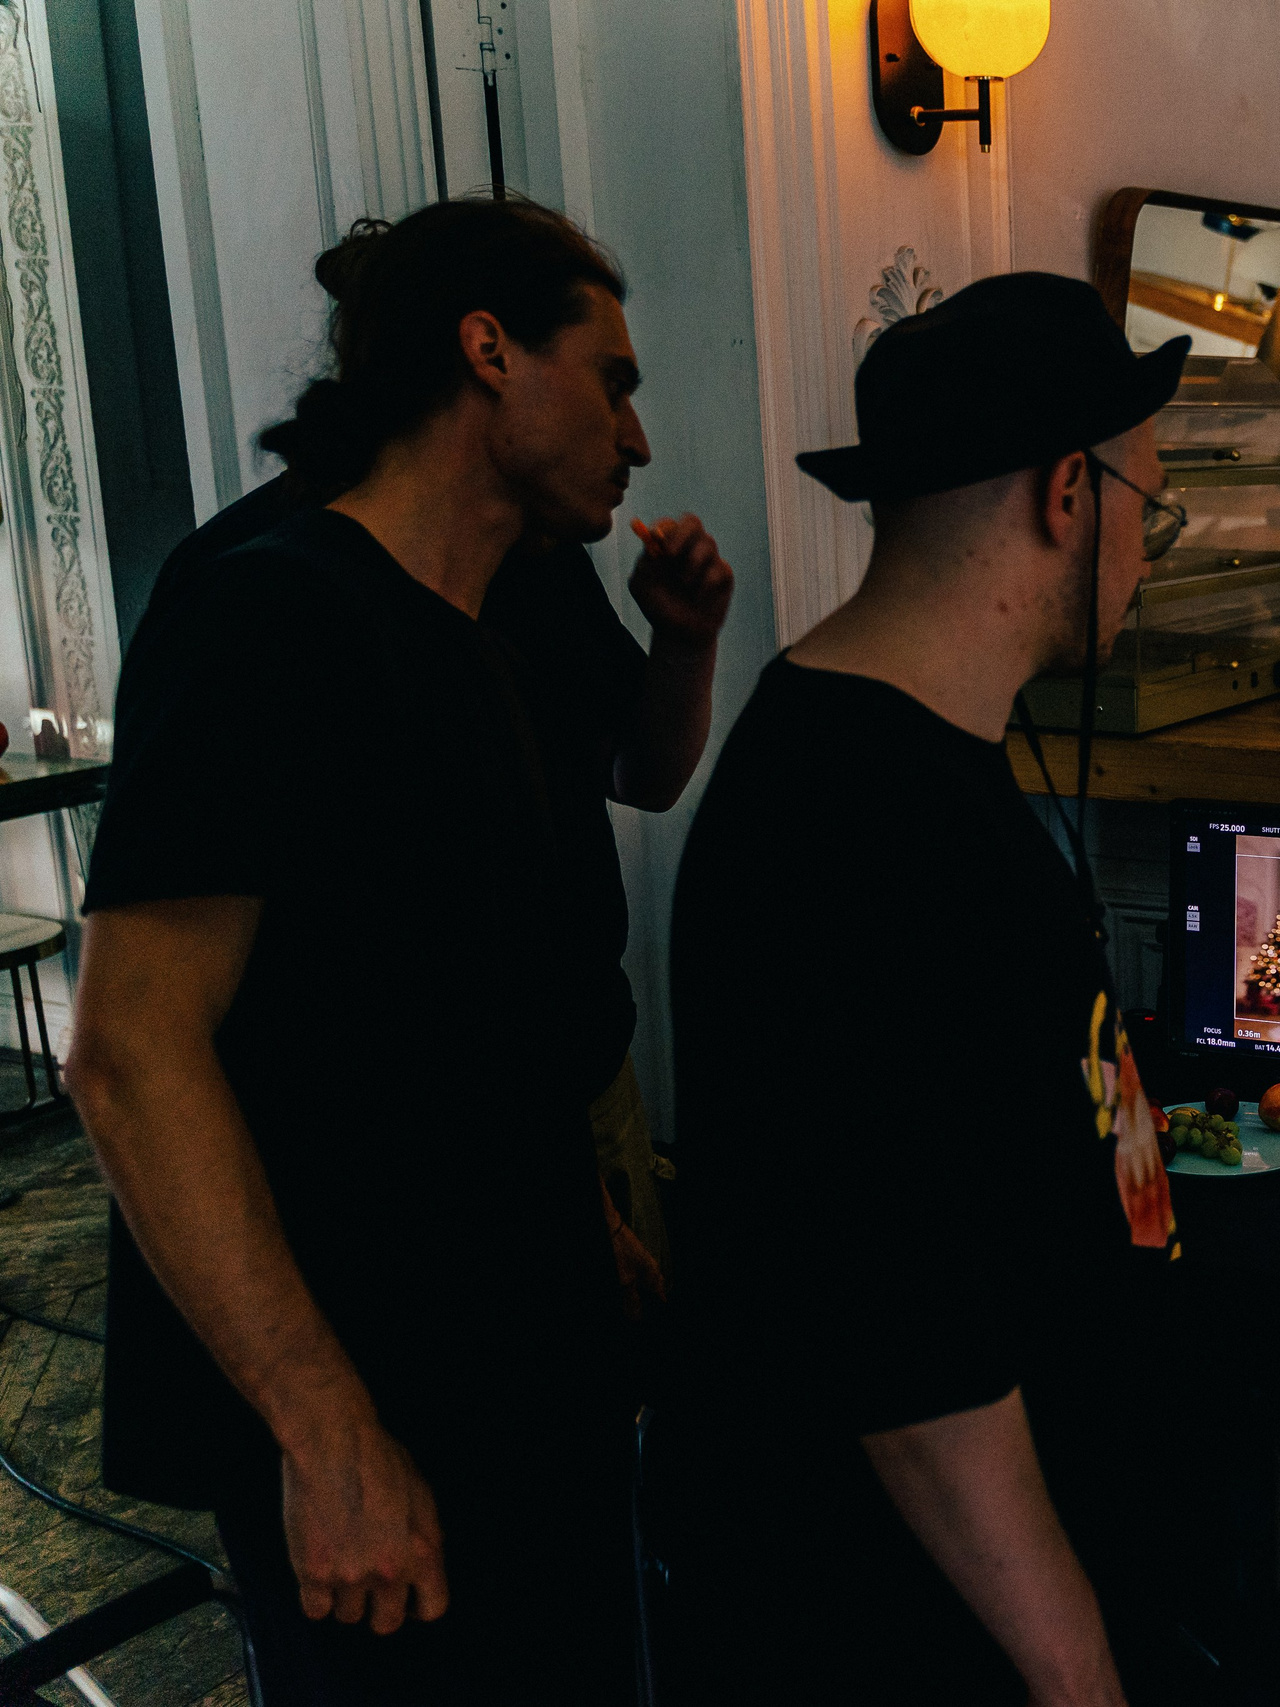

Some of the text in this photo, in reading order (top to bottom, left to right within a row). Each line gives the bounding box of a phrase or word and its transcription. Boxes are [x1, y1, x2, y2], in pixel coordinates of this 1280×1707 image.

[1220, 824, 1245, 833] 25.000
[1203, 1027, 1222, 1035] FOCUS
[1237, 1029, 1261, 1039] 0.36m
[1196, 1037, 1206, 1045] FCL
[1207, 1038, 1236, 1048] 18.0mm
